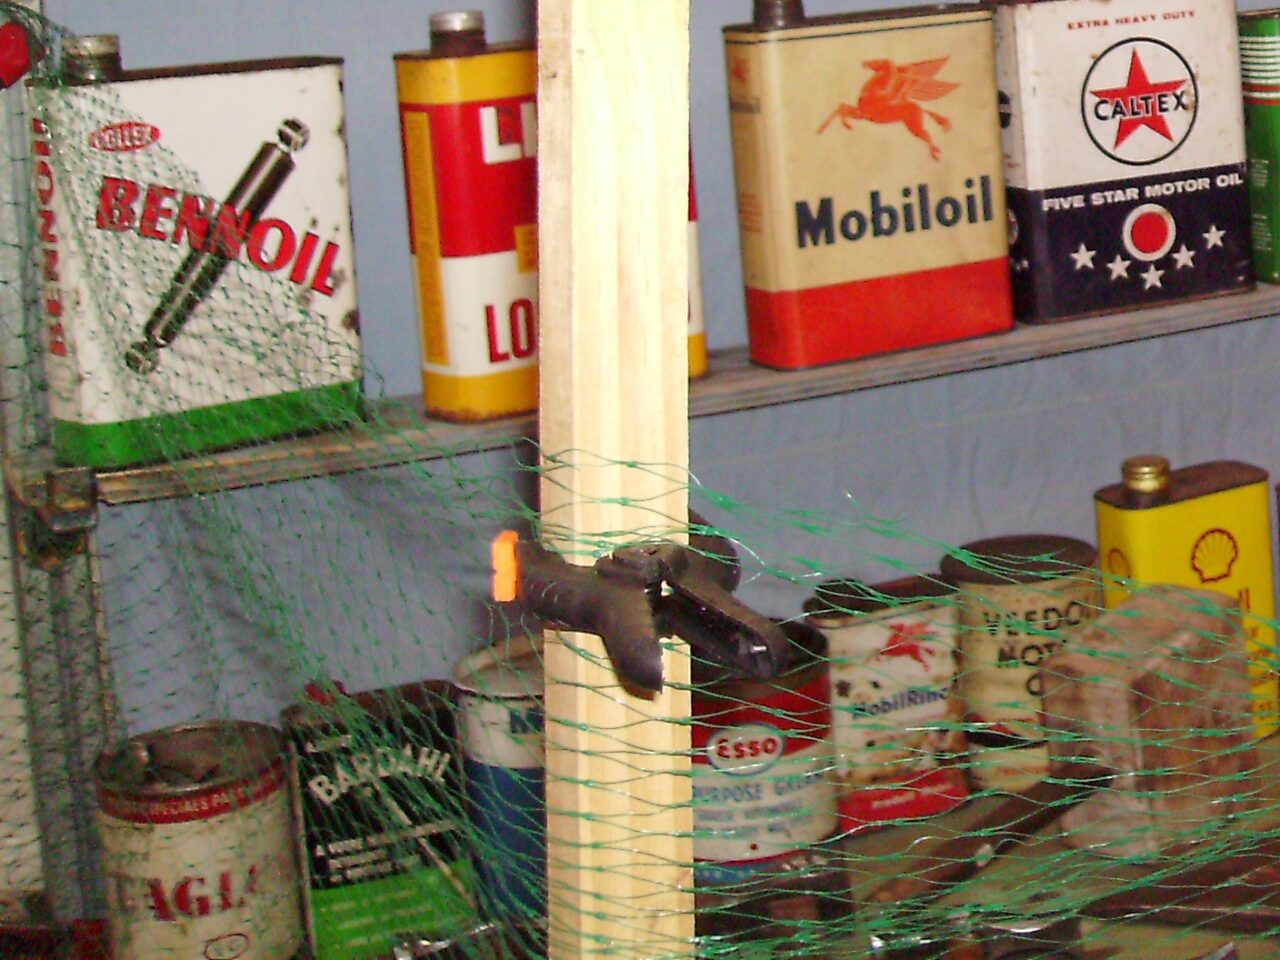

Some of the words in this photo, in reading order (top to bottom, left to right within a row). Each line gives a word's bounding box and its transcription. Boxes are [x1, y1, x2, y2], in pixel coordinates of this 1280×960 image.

[1067, 19, 1110, 31] EXTRA
[1115, 14, 1159, 26] HEAVY
[1163, 9, 1196, 21] DUTY
[1094, 90, 1190, 121] CALTEX
[1042, 194, 1085, 211] FIVE
[1090, 188, 1140, 206] STAR
[1144, 177, 1211, 198] MOTOR
[1216, 172, 1244, 187] OIL
[794, 174, 995, 250] Mobiloil
[96, 175, 340, 298] BENNOIL
[716, 737, 778, 759] Esso
